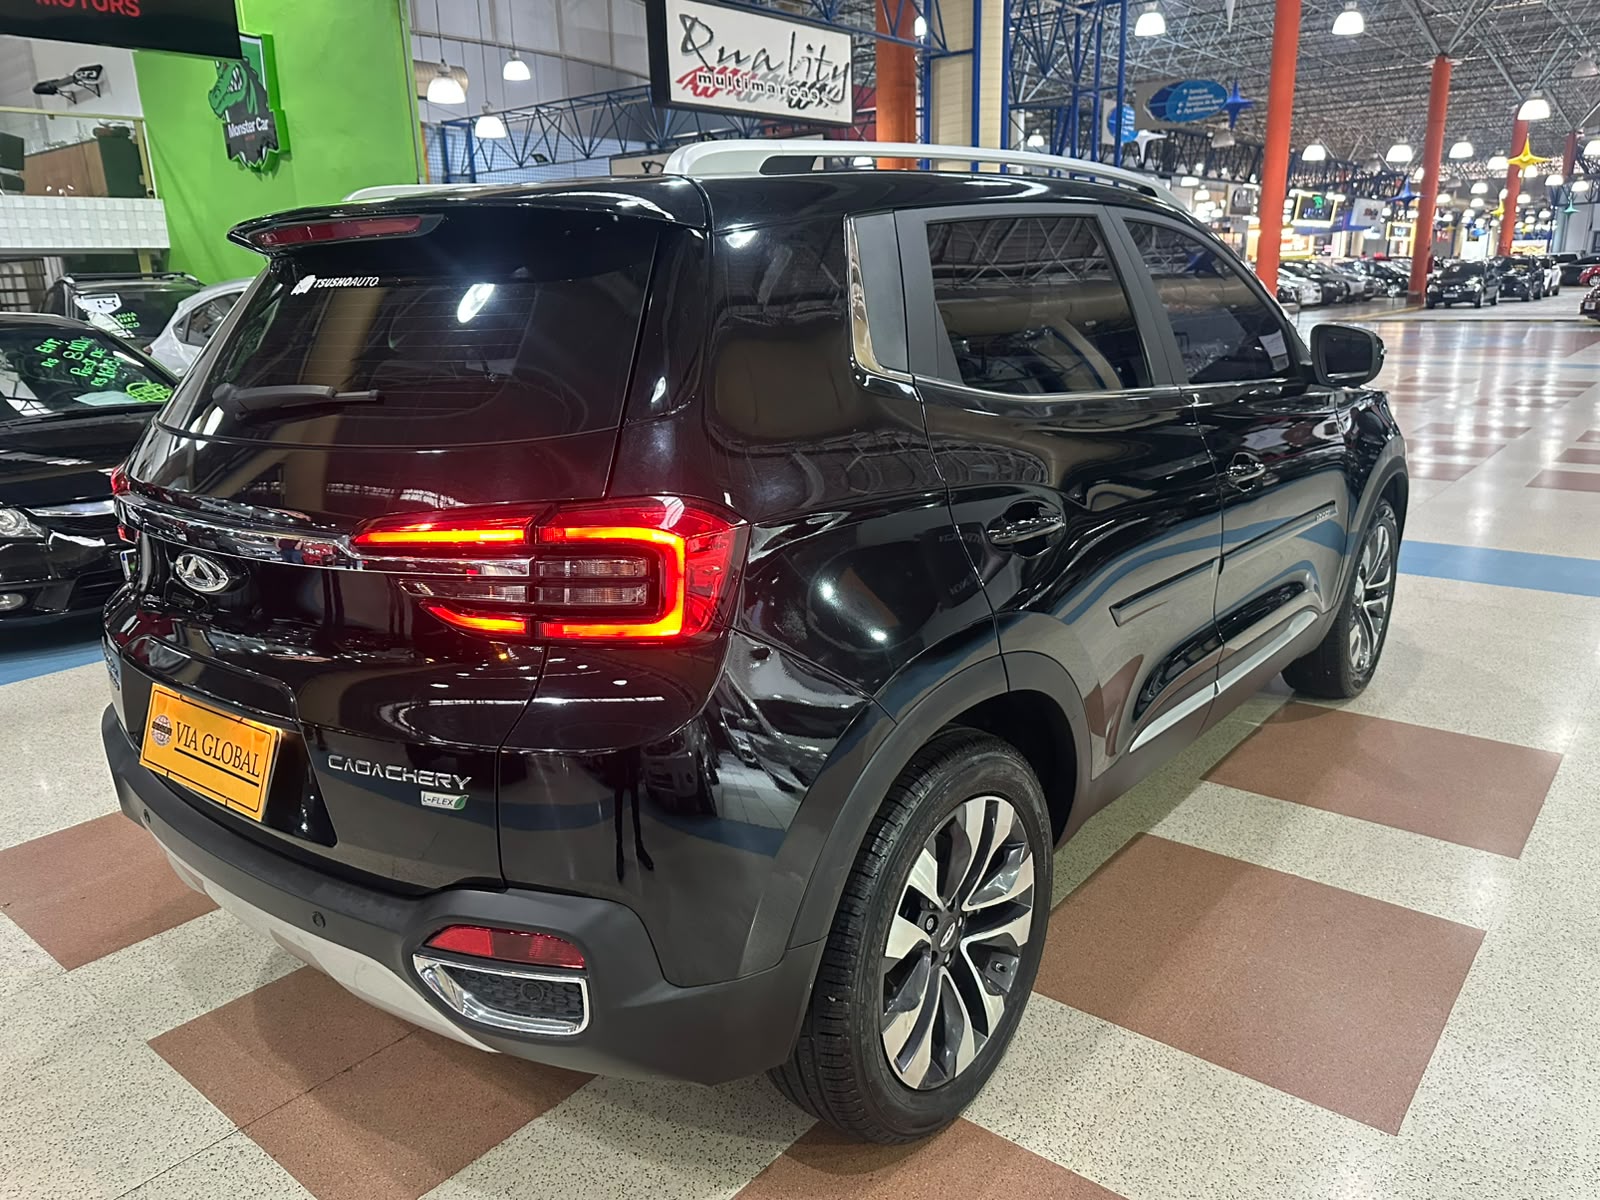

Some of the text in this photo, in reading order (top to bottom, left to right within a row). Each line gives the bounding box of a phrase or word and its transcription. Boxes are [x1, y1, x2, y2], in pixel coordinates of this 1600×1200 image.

[35, 0, 142, 18] ORS
[679, 13, 850, 104] Quality
[697, 72, 821, 100] multimarcas
[225, 119, 256, 139] Monster
[255, 116, 269, 132] Car
[313, 276, 380, 289] TSUSHOAUTO
[176, 721, 199, 752] VIA
[202, 733, 260, 778] GLOBAL
[422, 792, 454, 806] L-FLEX
